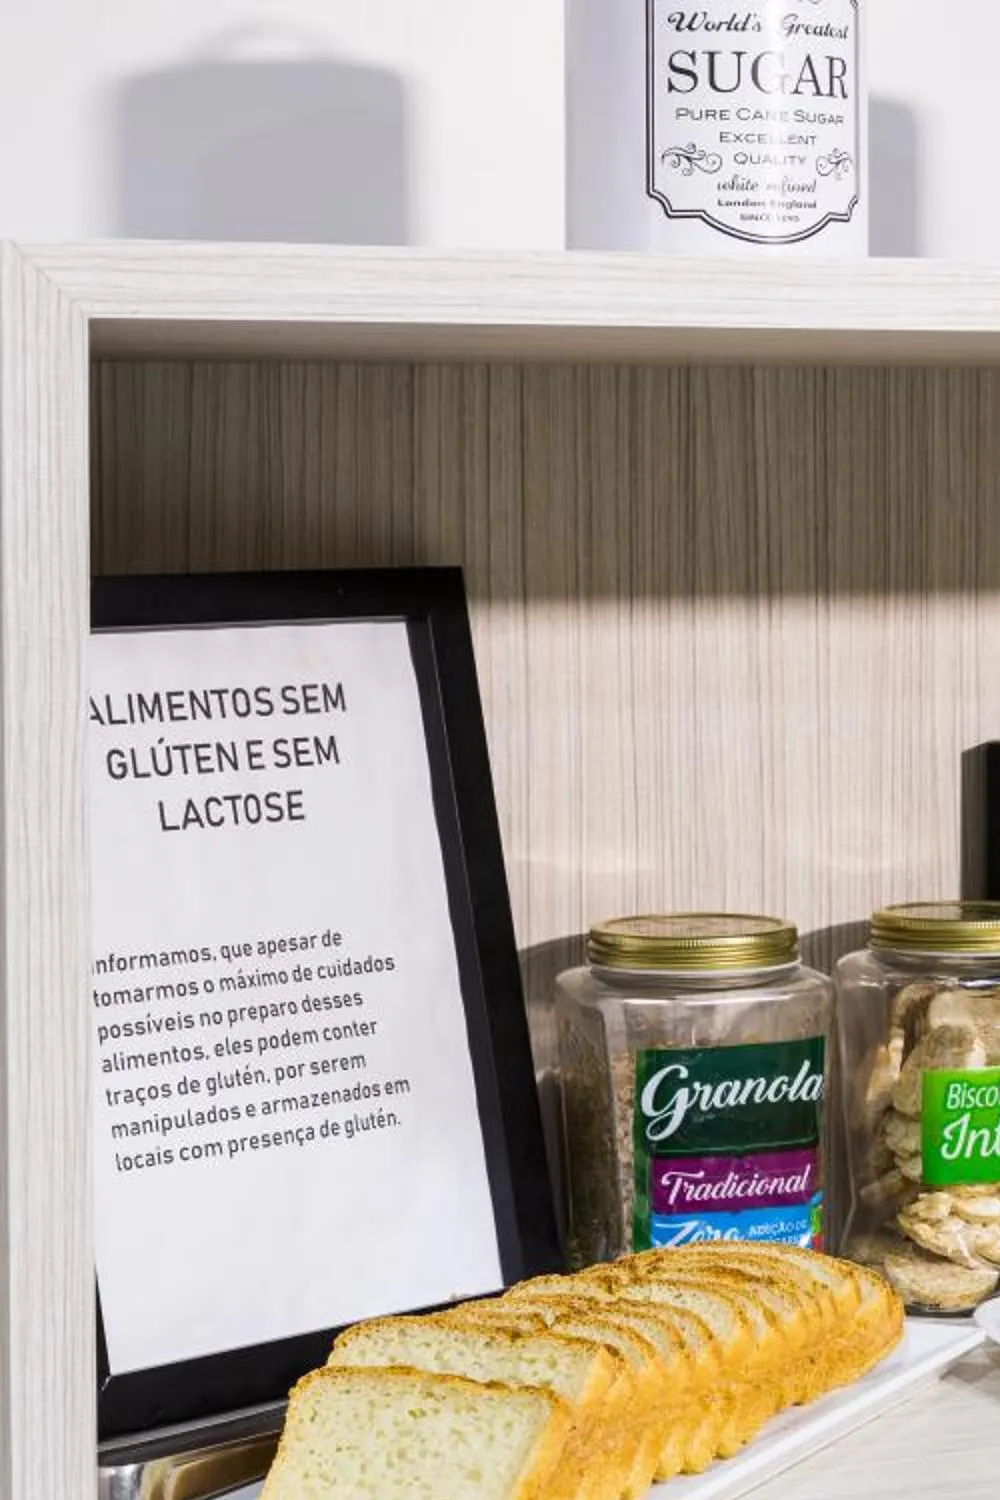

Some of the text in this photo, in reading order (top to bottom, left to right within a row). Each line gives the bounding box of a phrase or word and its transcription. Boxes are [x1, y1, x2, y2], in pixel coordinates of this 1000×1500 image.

[667, 11, 849, 39] World's Greatest
[667, 50, 848, 99] SUGAR
[717, 173, 759, 192] white
[281, 682, 347, 715] SEM
[106, 735, 340, 780] GLÚTEN E SEM
[158, 789, 306, 832] LACTOSE
[221, 941, 252, 963] que
[257, 931, 317, 959] apesar
[321, 929, 342, 948] de
[93, 954, 395, 1008] tomarmos o máximo de cuidados
[97, 990, 363, 1046] possíveis no preparo desses
[102, 1020, 378, 1074] alimentos, eles podem conter
[105, 1053, 367, 1107] traços de glutén, por serem
[640, 1059, 824, 1141] Granola
[111, 1077, 411, 1139] manipulados e armazenados em
[115, 1108, 401, 1172] locais com presença de glutén.
[661, 1163, 811, 1206] Tradicional
